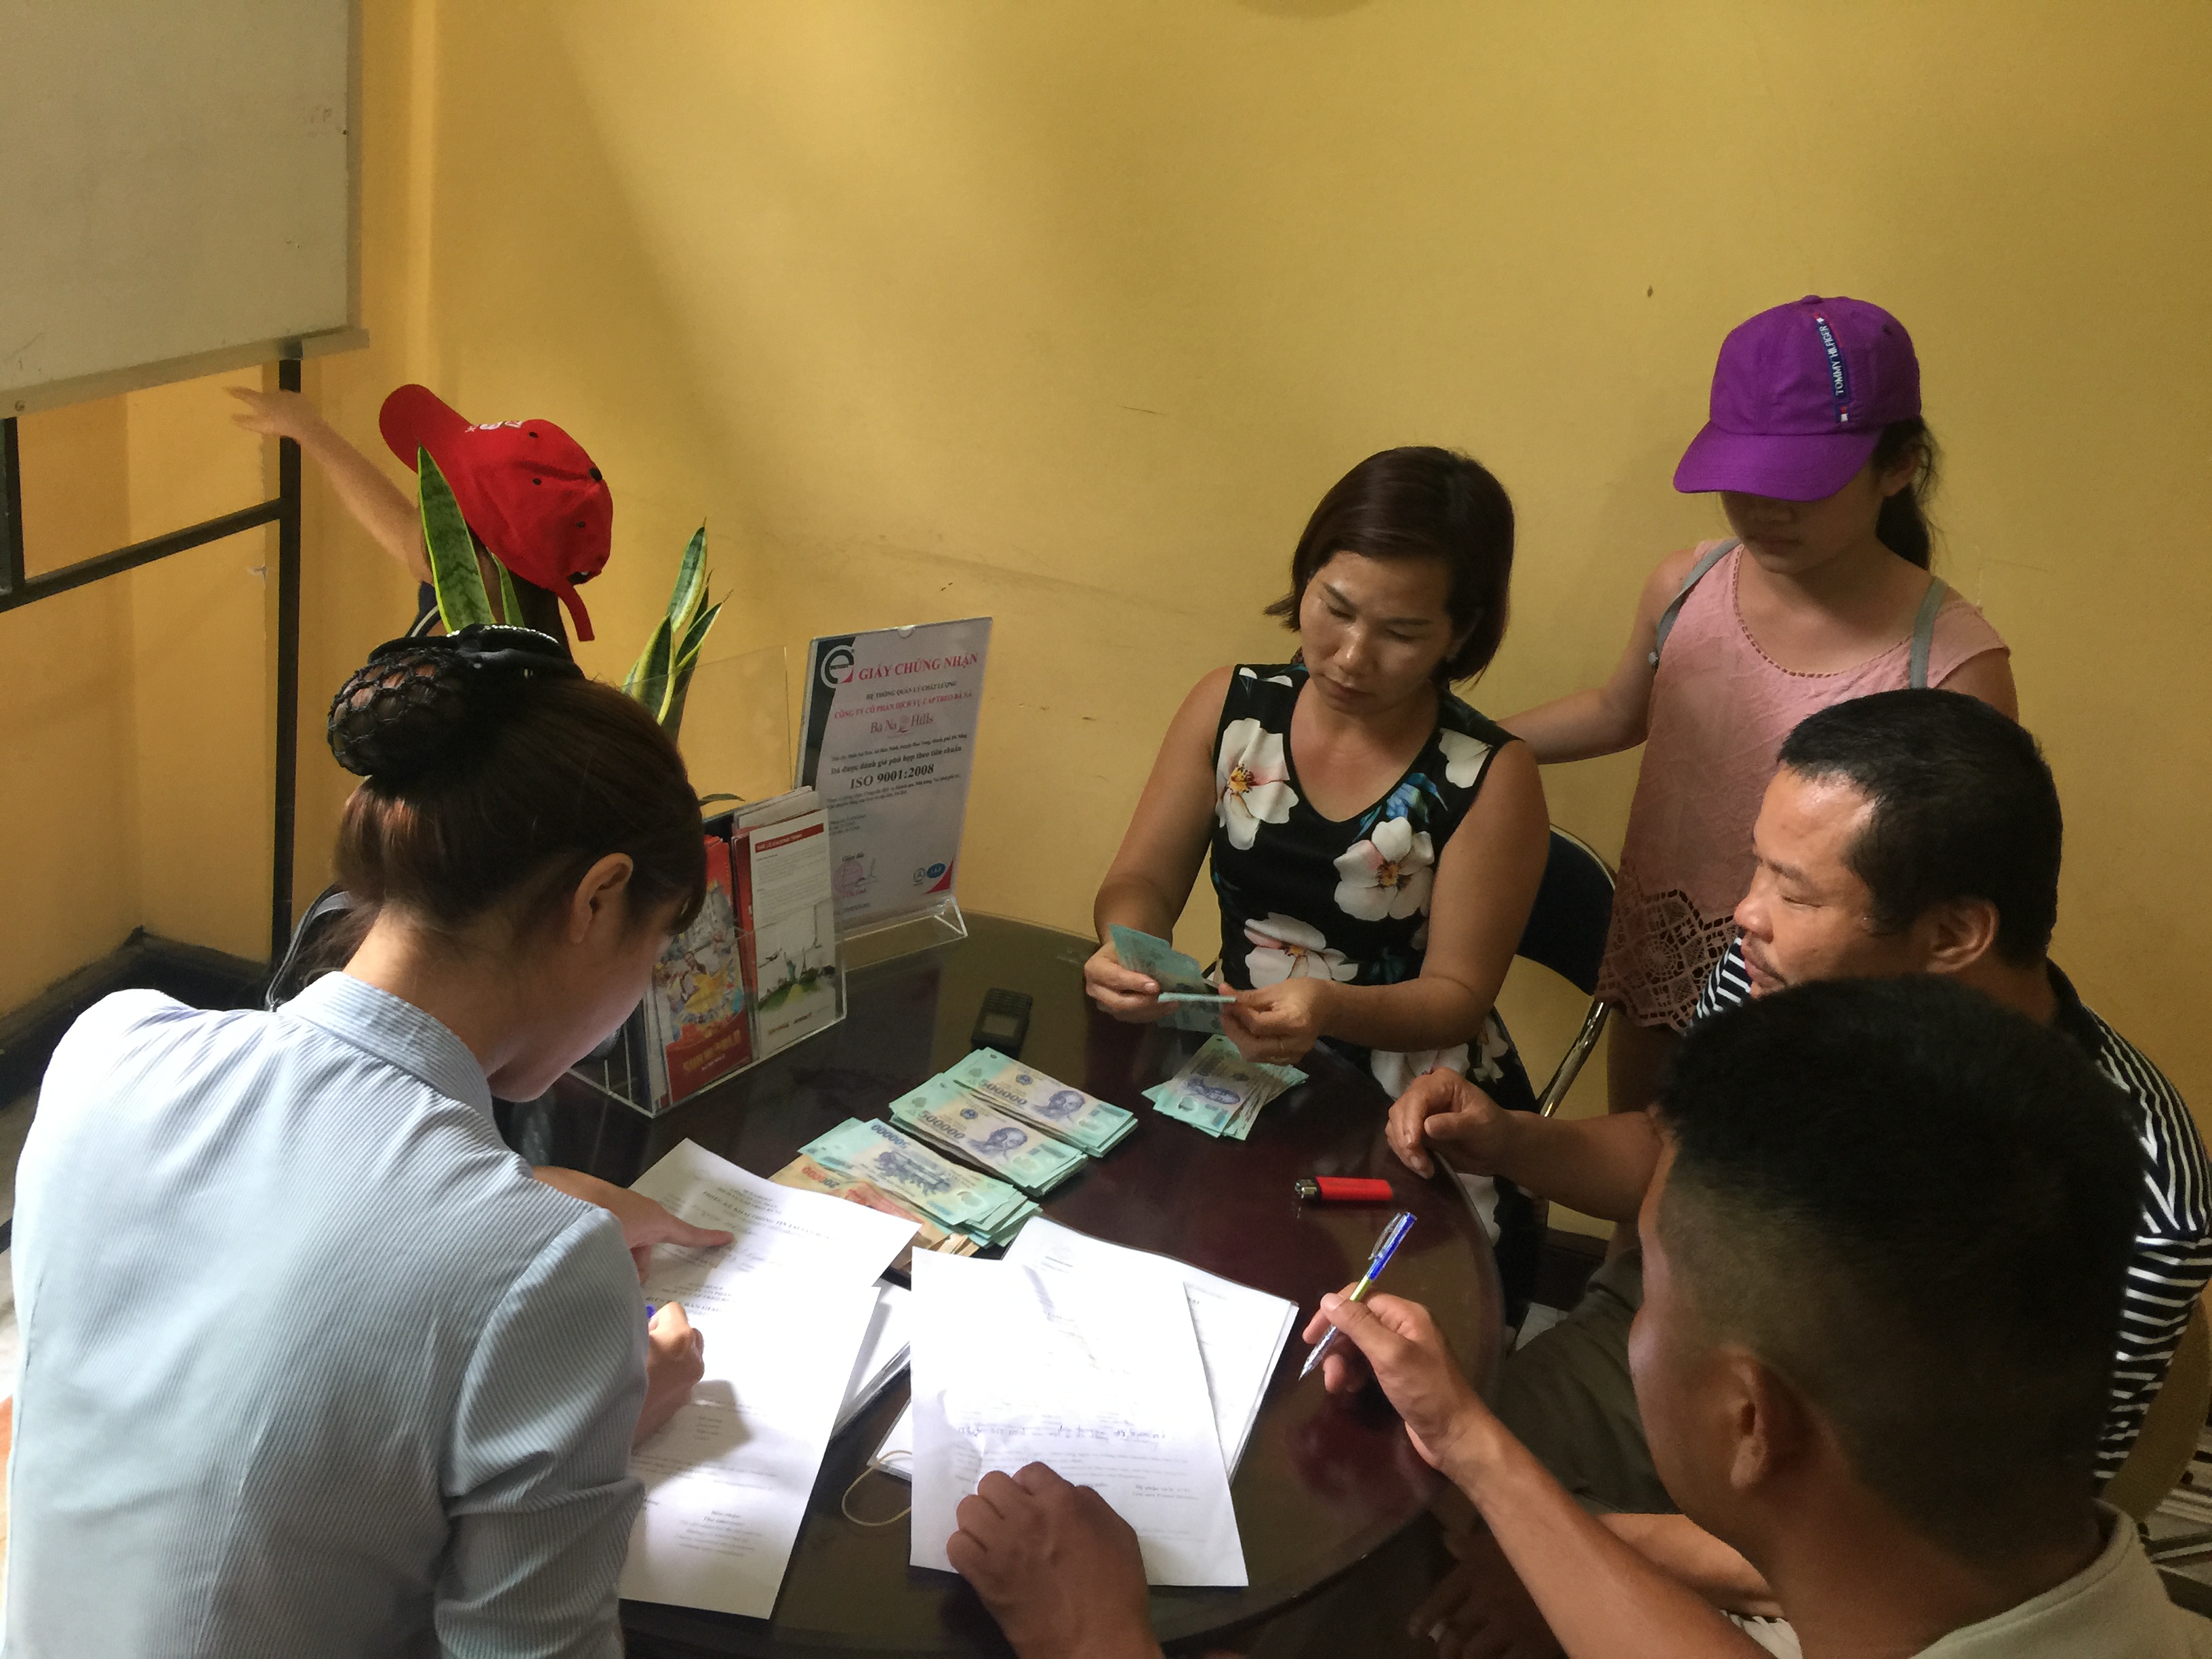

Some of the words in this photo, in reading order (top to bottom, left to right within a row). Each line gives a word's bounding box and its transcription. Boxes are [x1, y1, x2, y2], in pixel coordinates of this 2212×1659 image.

[1820, 325, 1839, 359] HILFIGER
[1830, 361, 1844, 396] TOMMY
[910, 713, 933, 727] Hills
[850, 775, 874, 790] ISO
[877, 764, 935, 784] 9001:2008
[979, 1079, 1028, 1106] 500000
[871, 1123, 912, 1149] 500000
[918, 1109, 966, 1140] 500000
